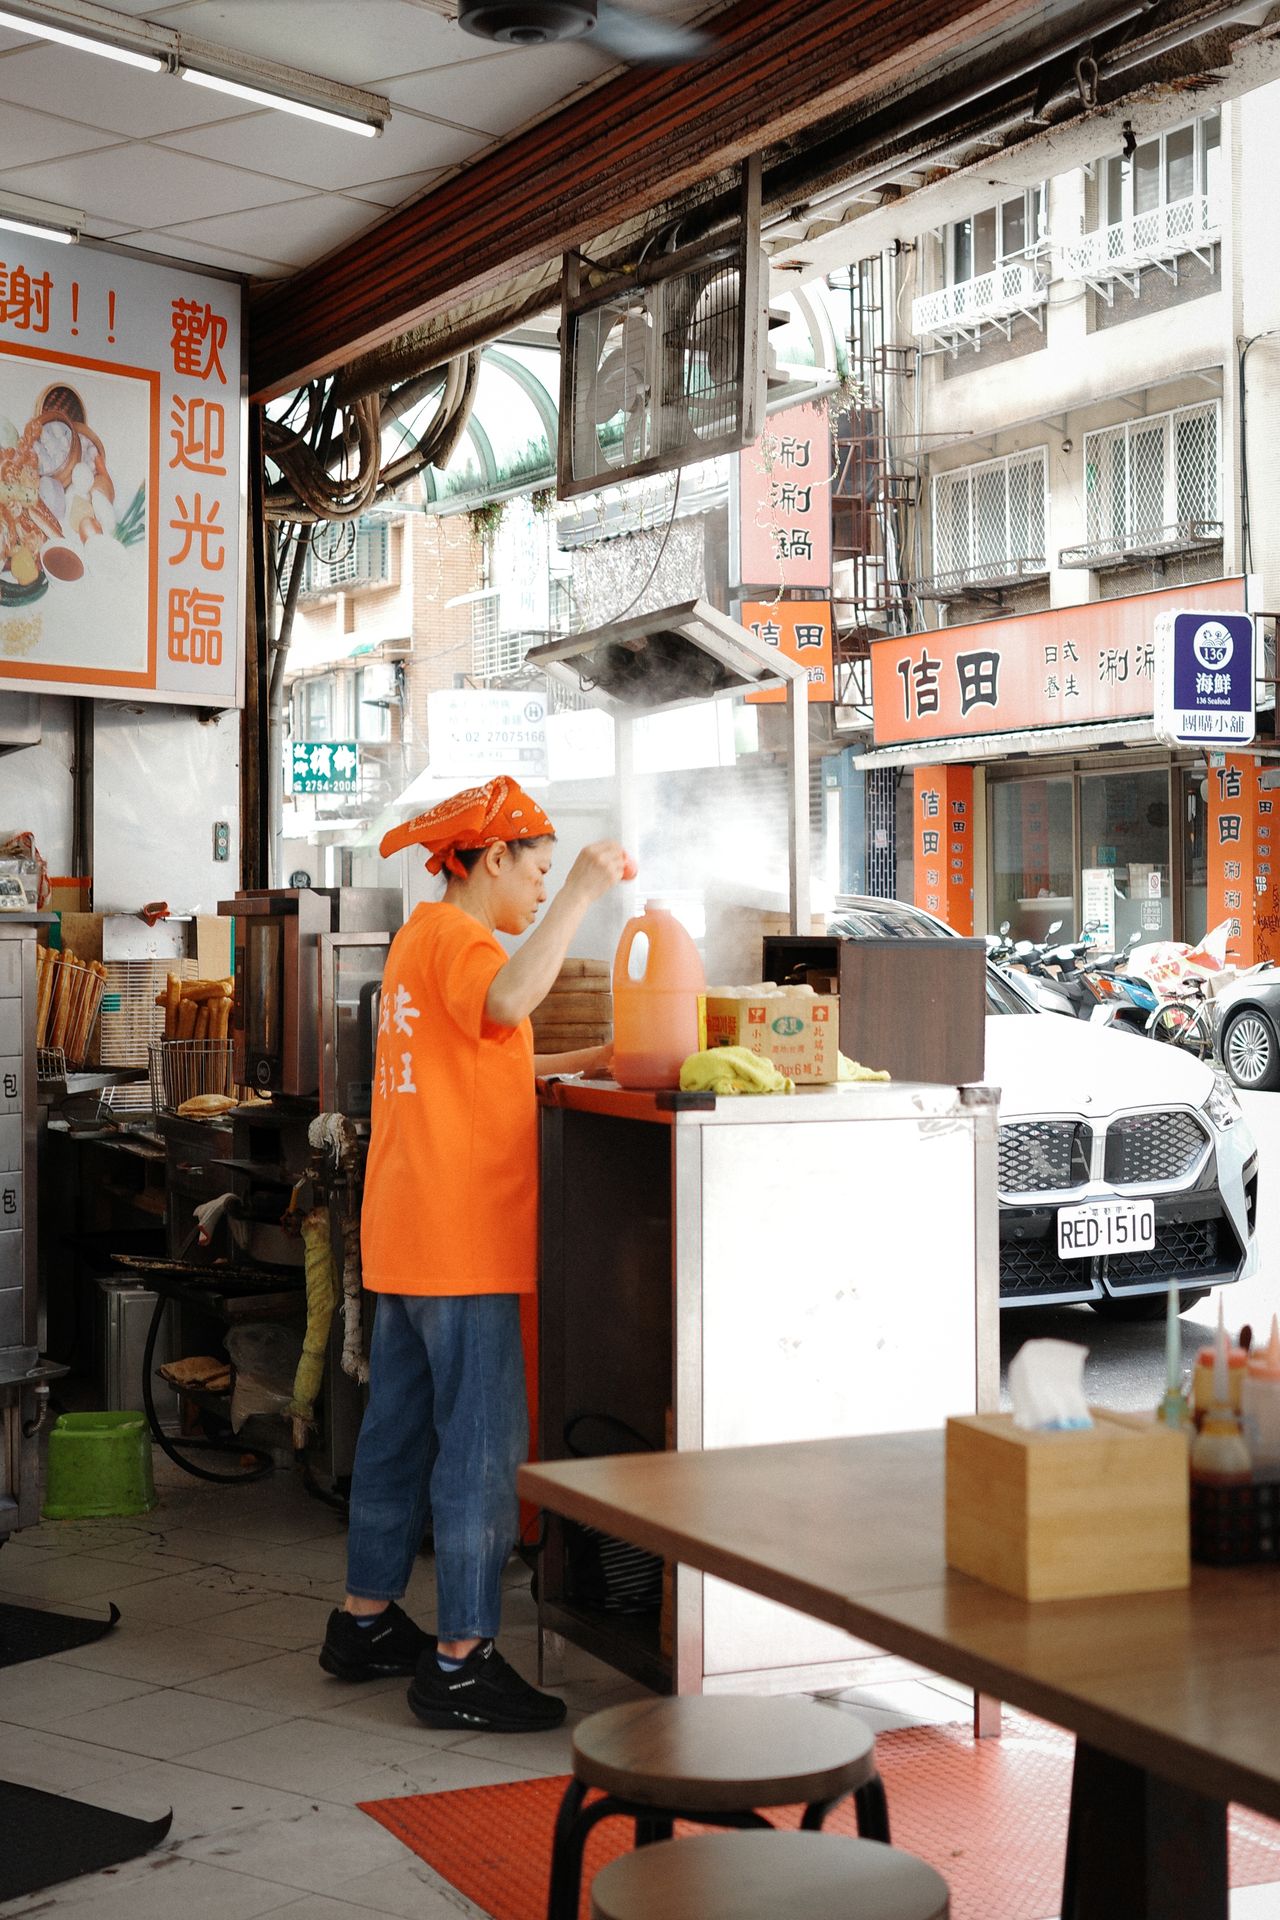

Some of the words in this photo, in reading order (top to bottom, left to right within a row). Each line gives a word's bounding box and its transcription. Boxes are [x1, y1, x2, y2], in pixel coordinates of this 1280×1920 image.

[168, 297, 228, 667] 歡迎光臨
[1044, 641, 1079, 665] 日式
[1204, 647, 1224, 661] 136
[1195, 672, 1232, 695] 海鮮
[1207, 697, 1231, 706] Seafood
